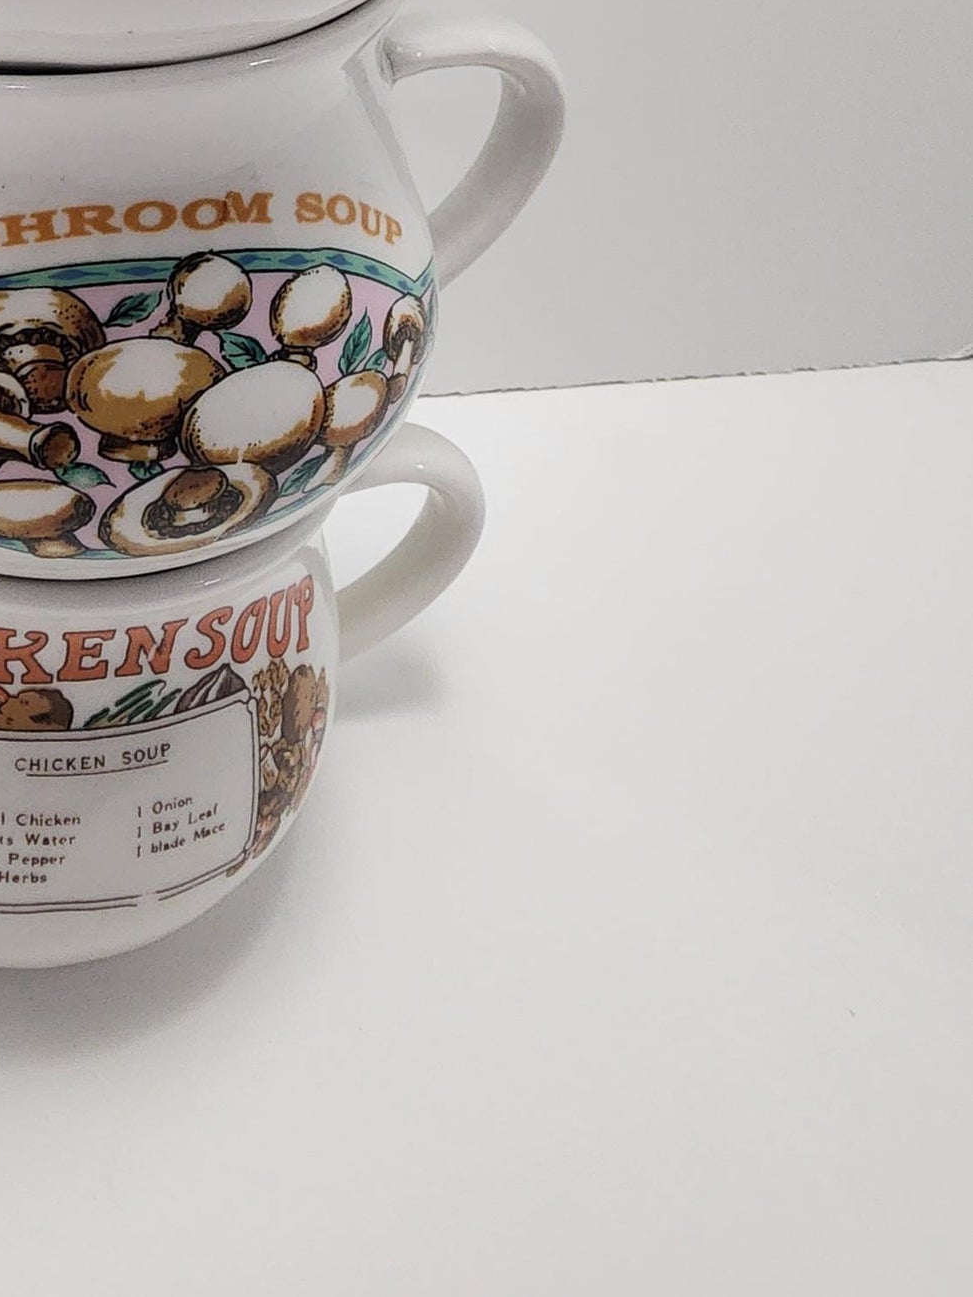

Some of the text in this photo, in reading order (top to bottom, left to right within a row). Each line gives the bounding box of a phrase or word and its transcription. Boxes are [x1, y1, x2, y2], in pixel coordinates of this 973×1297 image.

[293, 191, 404, 246] SOUP
[183, 573, 316, 670] SOUP
[14, 743, 171, 772] CHICKEN SOUP
[15, 811, 82, 828] Chicken
[151, 795, 194, 816] Onion
[151, 818, 181, 837] Bay
[187, 802, 220, 826] Leaf
[24, 831, 78, 847] Water
[149, 836, 187, 856] blade
[192, 820, 227, 843] Mace
[7, 852, 67, 869] Pepper
